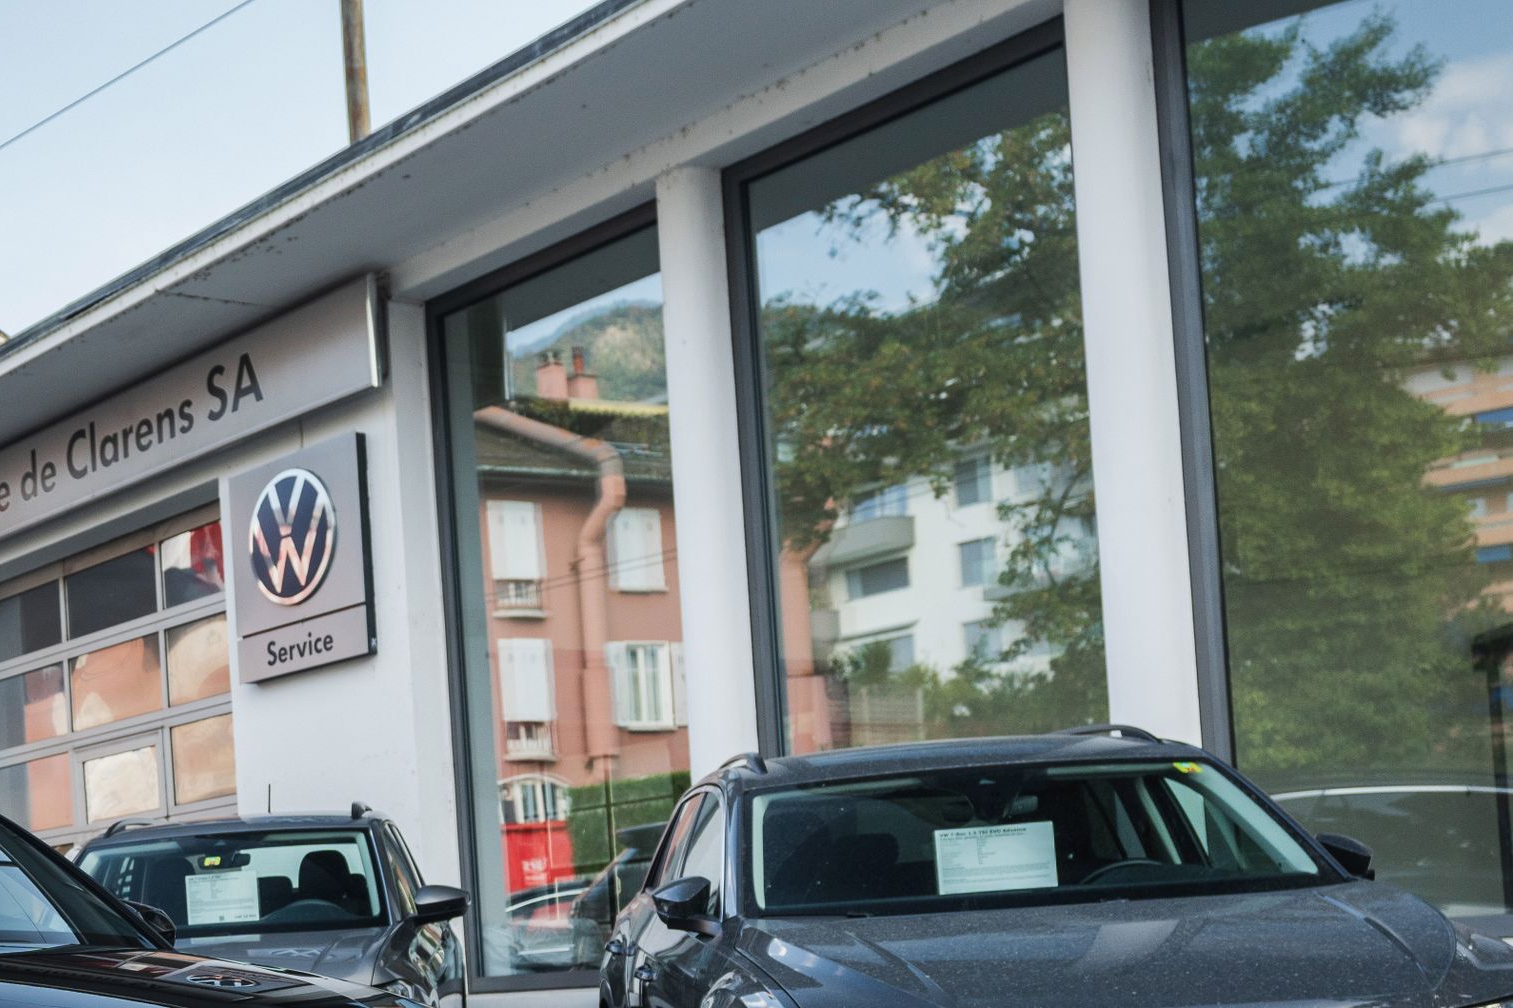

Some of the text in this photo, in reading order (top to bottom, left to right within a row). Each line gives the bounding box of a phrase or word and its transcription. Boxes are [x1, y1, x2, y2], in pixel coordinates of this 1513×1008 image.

[21, 448, 57, 501] de
[66, 399, 195, 480] Clarens
[207, 352, 264, 421] SA
[267, 632, 334, 666] Service
